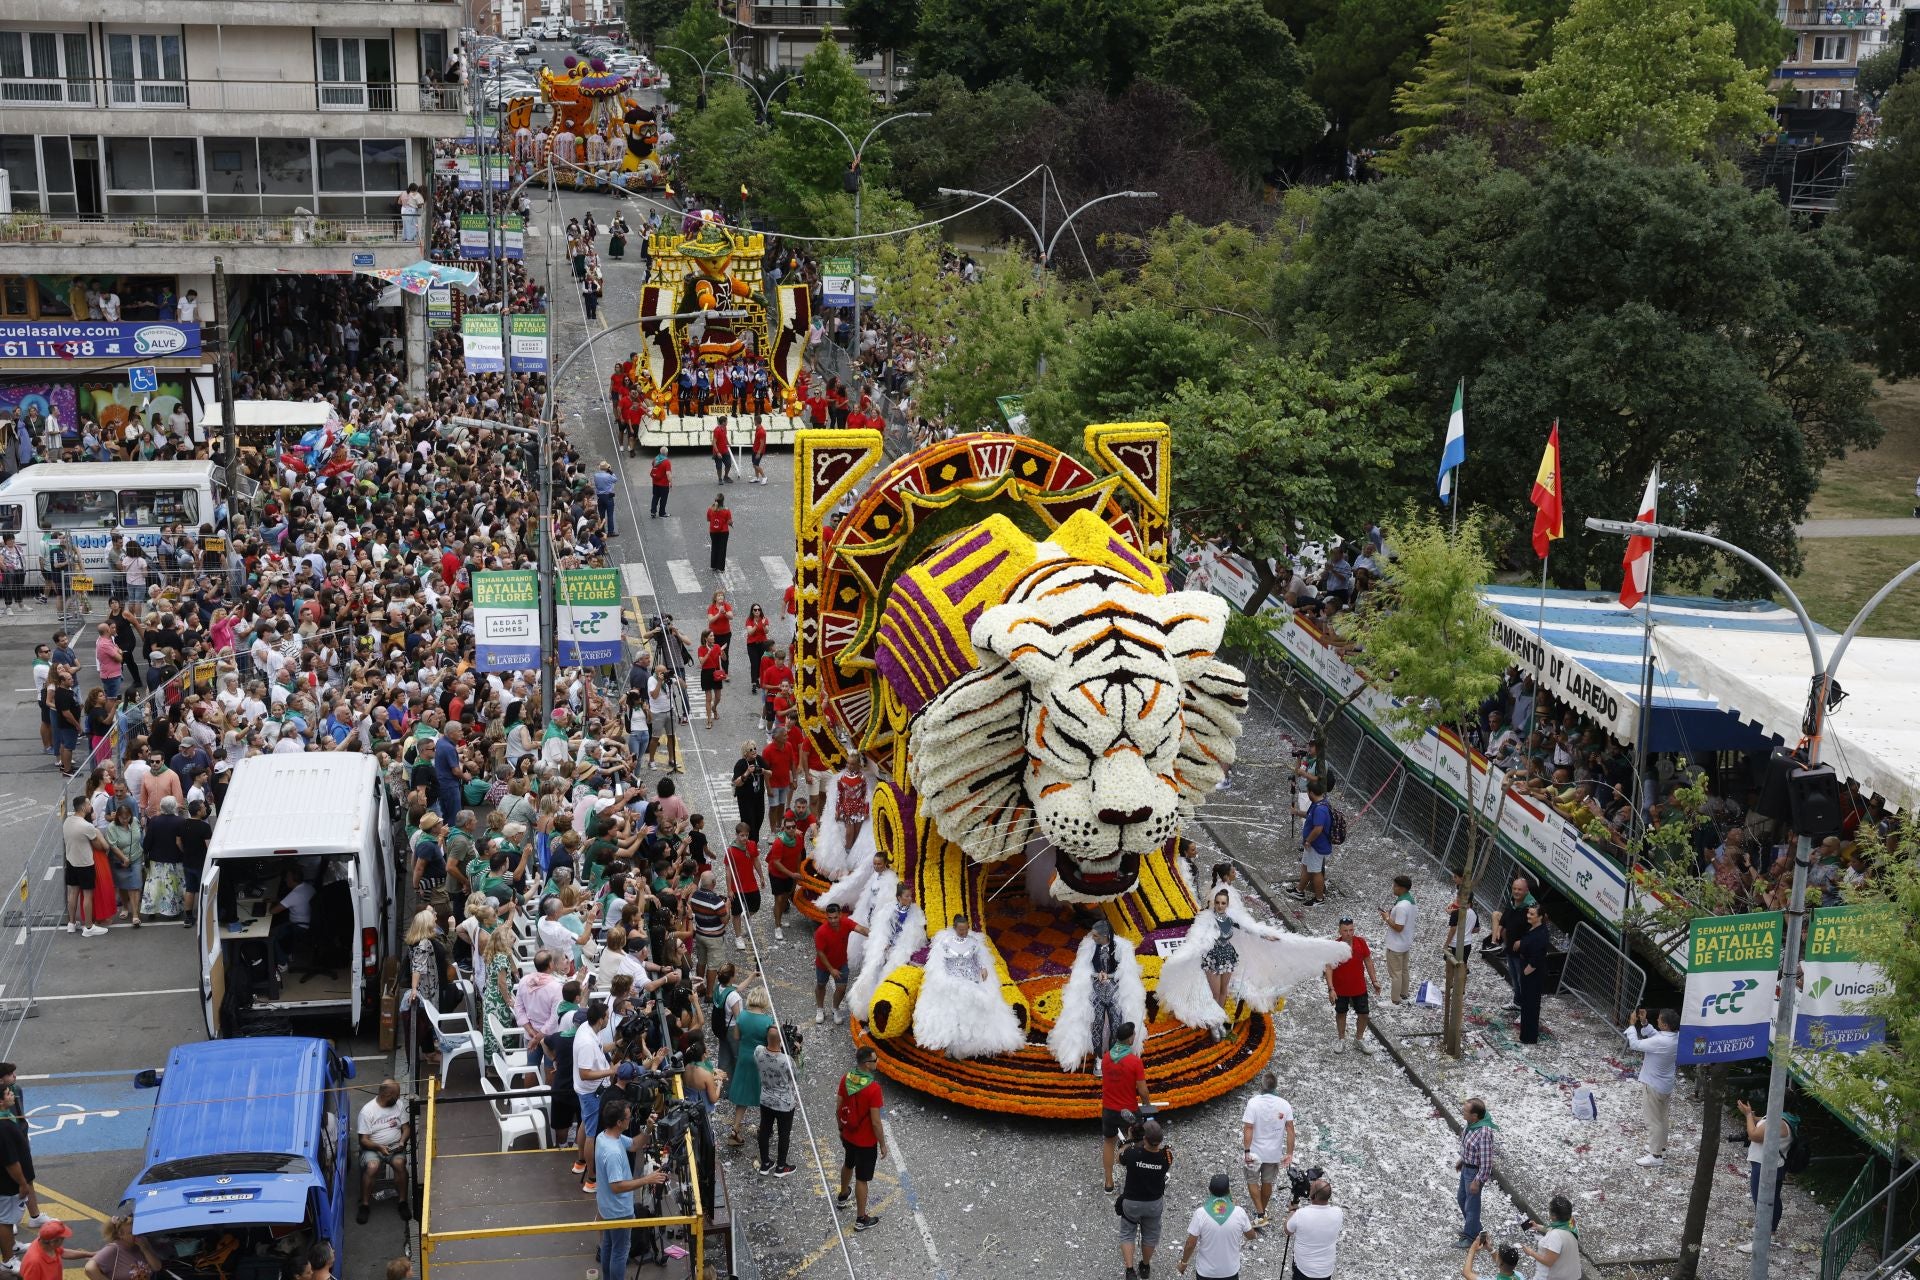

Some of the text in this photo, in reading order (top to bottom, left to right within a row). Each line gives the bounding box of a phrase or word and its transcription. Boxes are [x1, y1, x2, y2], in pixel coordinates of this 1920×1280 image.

[4, 341, 28, 356] 61
[477, 583, 533, 594] BATALLA
[577, 590, 615, 600] FLORES
[478, 592, 533, 603] DE FLORES
[497, 656, 531, 664] LAREDO
[1492, 620, 1618, 722] TAMIENTO DE LAREDO
[1816, 916, 1853, 926] SEMANA
[1697, 921, 1776, 935] SEMANA GRANDE
[1695, 931, 1774, 952] BATALLA
[1811, 942, 1831, 954] DE
[1695, 946, 1774, 965] DE FLORES
[1834, 982, 1887, 998] Unicaja
[1701, 992, 1745, 1017] FCC
[1708, 1038, 1748, 1047] AYUNTAMIENTO
[1824, 1032, 1870, 1045] LAREDO
[1707, 1041, 1754, 1054] LAREDO
[1136, 1161, 1162, 1170] TÉCNICOS
